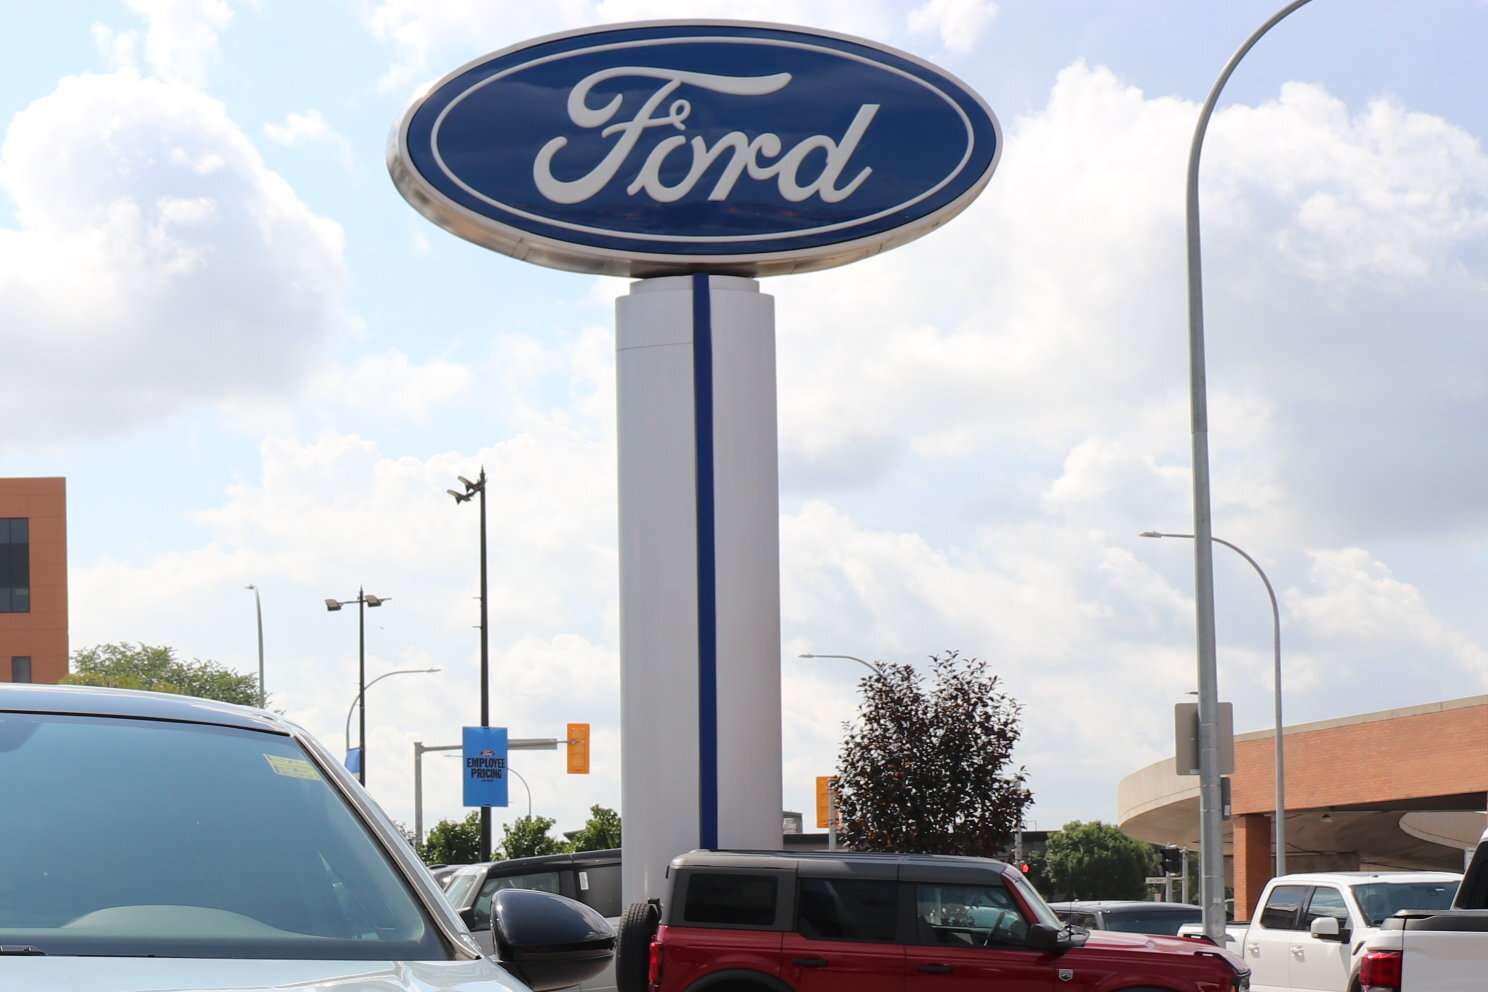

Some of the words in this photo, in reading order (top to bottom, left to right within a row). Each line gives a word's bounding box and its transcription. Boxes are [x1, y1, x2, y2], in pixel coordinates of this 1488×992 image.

[532, 65, 881, 205] Ford
[466, 758, 505, 768] EMPLOYEE
[471, 768, 502, 779] PRICING
